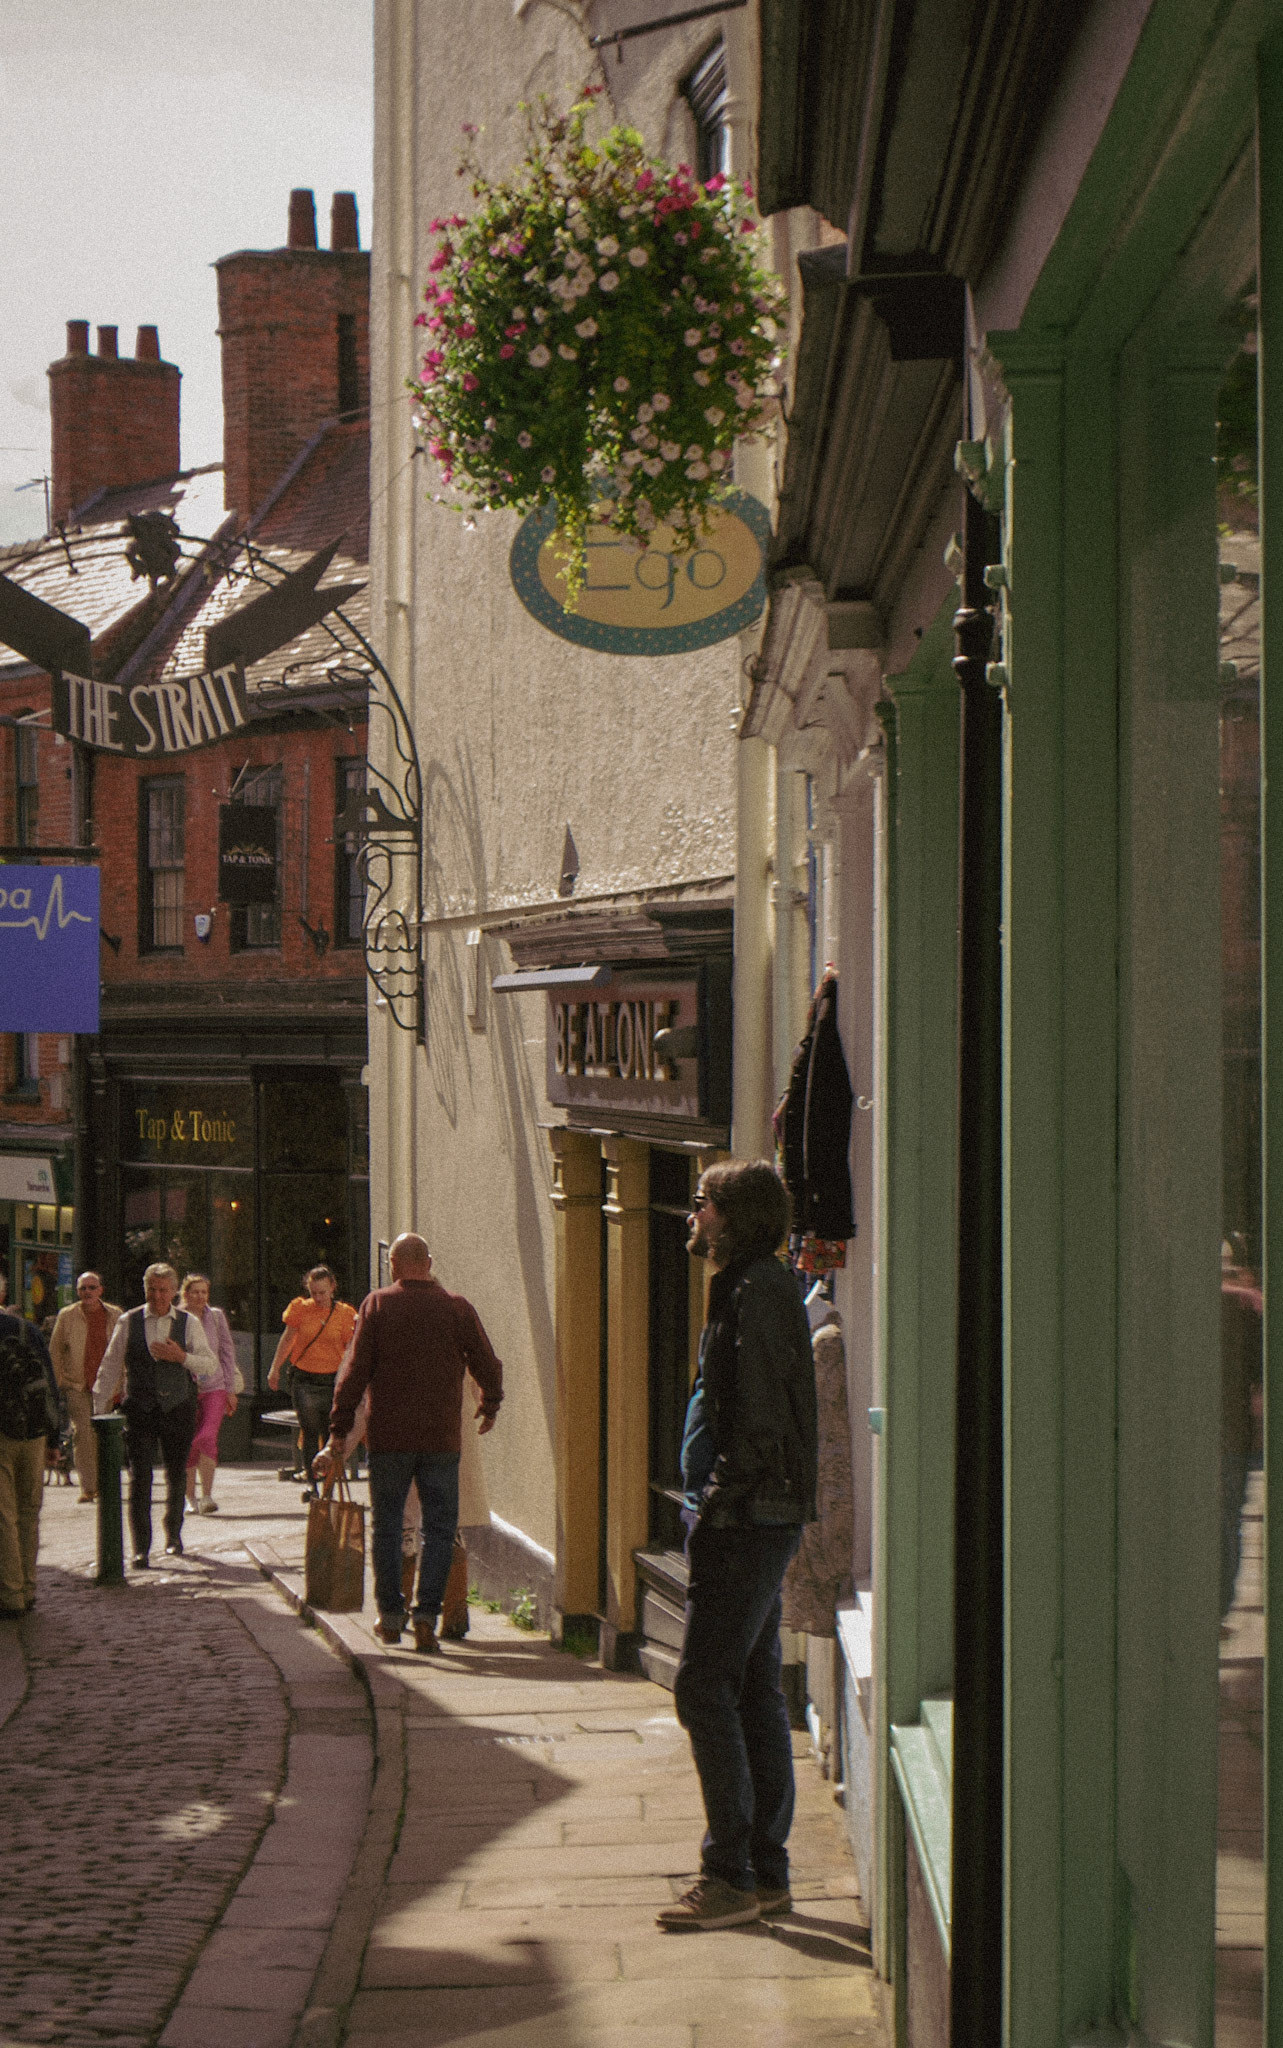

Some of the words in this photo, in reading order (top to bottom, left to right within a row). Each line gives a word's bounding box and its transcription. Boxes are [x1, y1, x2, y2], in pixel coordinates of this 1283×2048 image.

[580, 523, 726, 609] Ego
[62, 670, 123, 751] THE
[129, 663, 245, 753] STRAIT
[135, 1109, 166, 1149] Tap
[170, 1110, 185, 1141] &
[189, 1110, 236, 1143] Tonic
